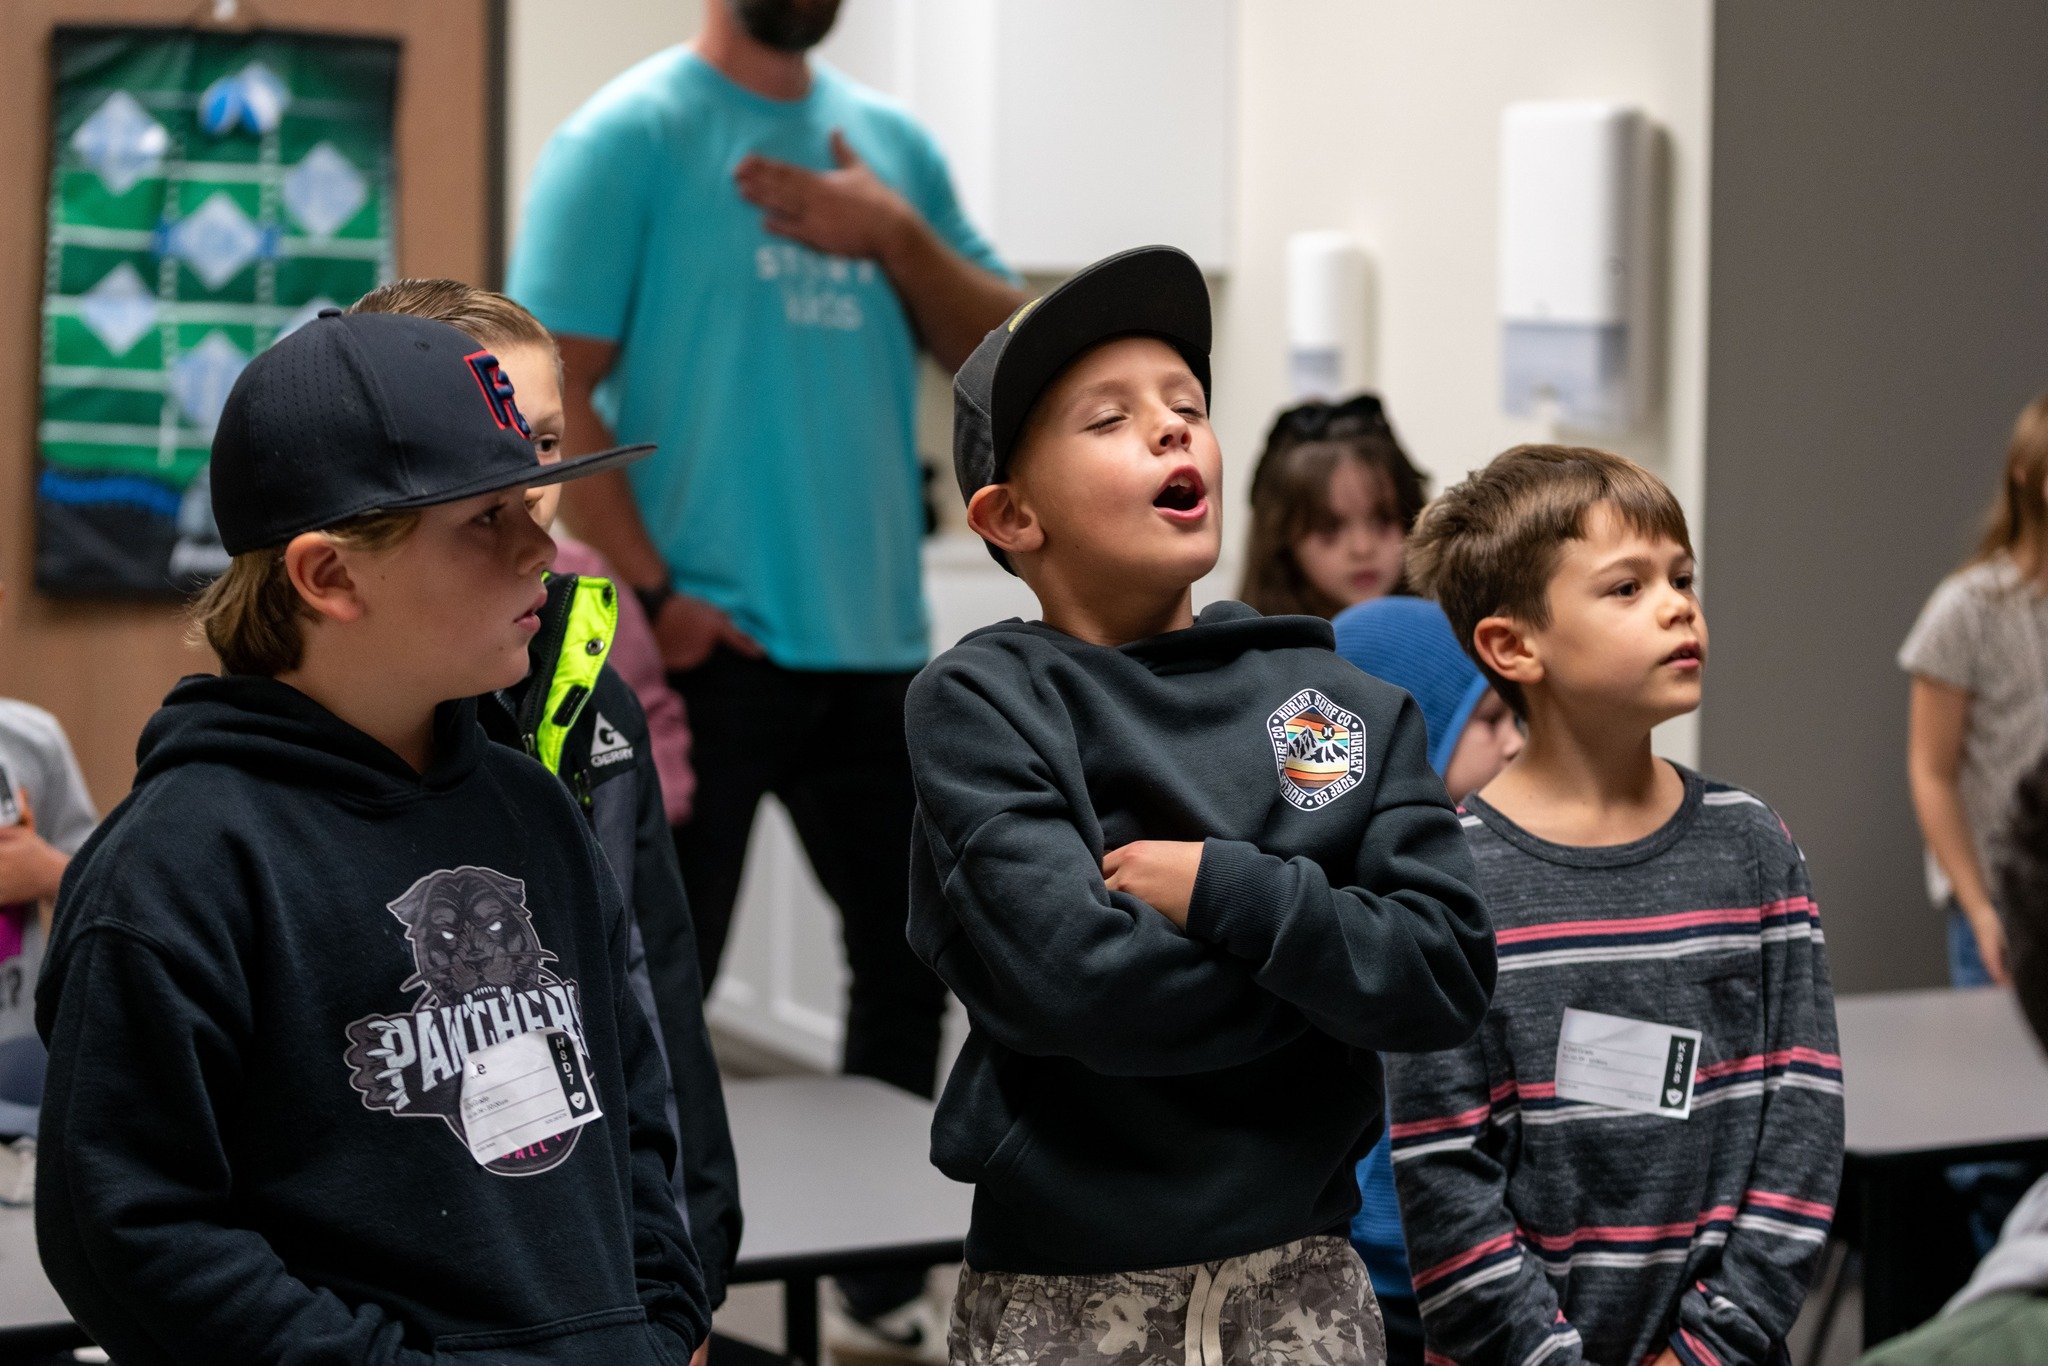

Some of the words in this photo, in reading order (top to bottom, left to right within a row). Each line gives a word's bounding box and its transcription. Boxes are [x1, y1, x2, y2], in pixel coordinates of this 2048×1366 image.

[1276, 692, 1312, 720] HURLEY
[1314, 694, 1337, 719] SURF
[1336, 711, 1352, 727] CO
[1271, 725, 1286, 739] CO
[591, 747, 633, 767] GERRY
[1350, 731, 1363, 774] HURLEY
[1330, 774, 1356, 796] SURF
[1314, 791, 1329, 804] CO
[555, 1037, 574, 1085] H8D7
